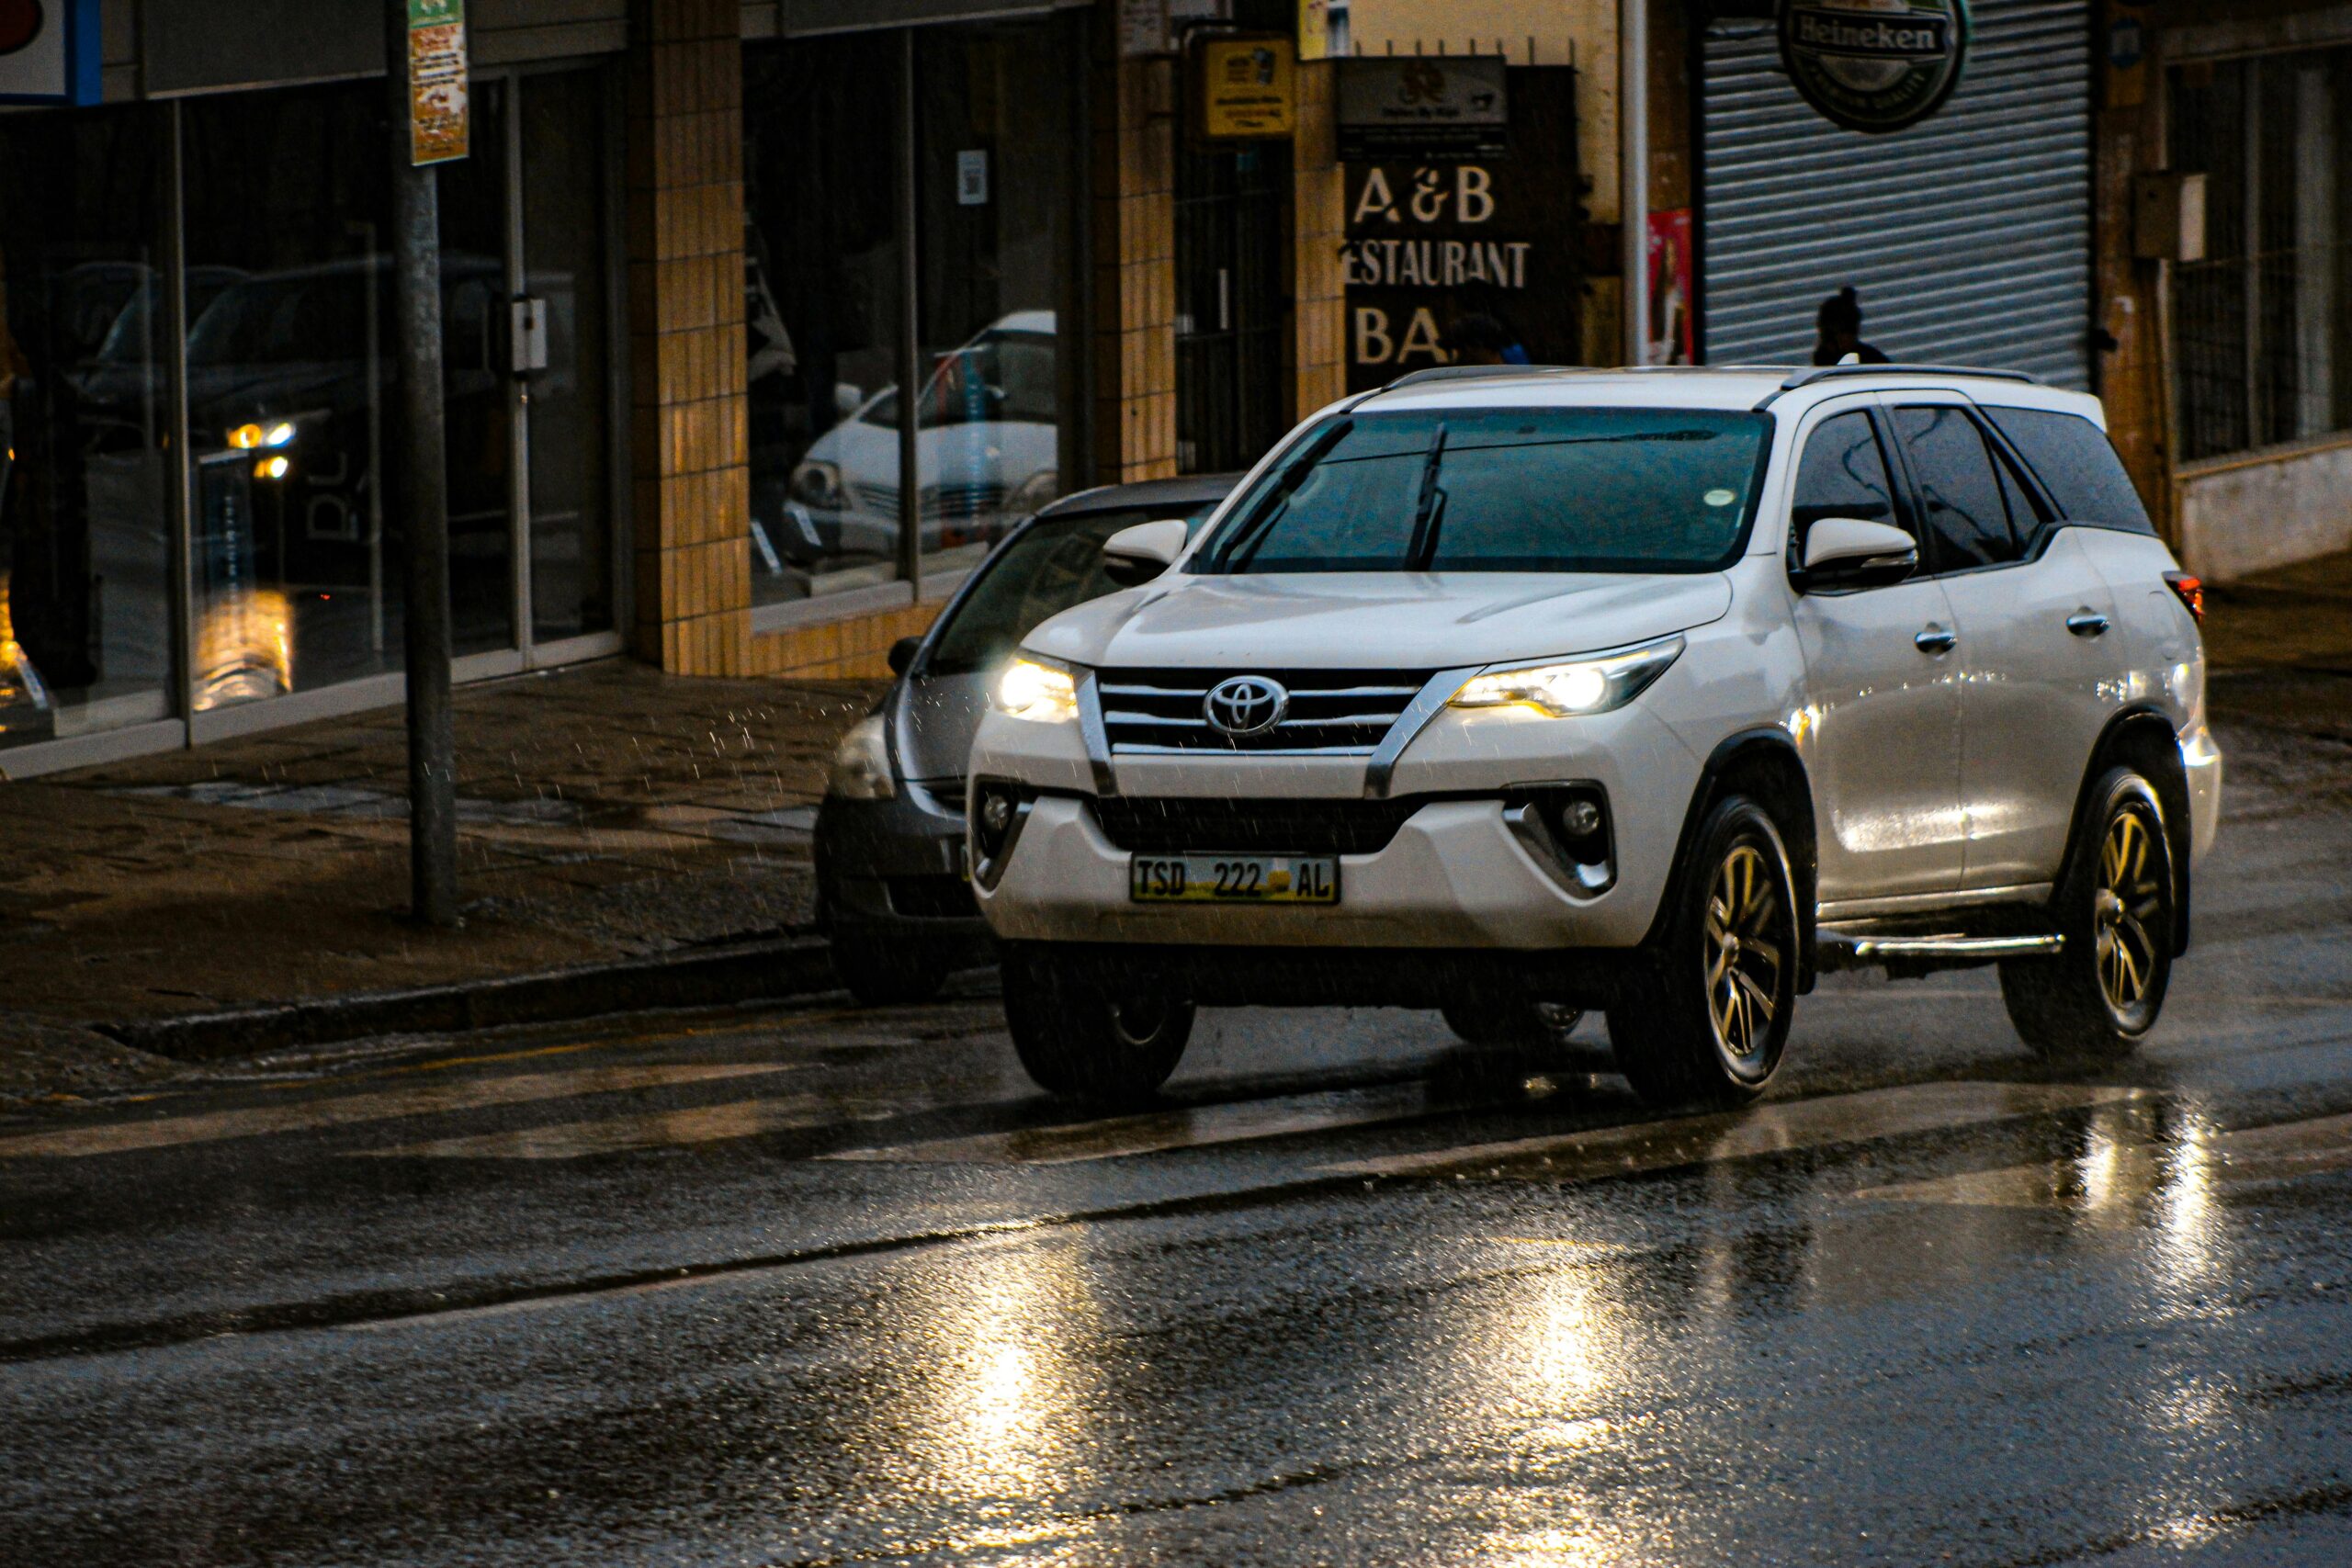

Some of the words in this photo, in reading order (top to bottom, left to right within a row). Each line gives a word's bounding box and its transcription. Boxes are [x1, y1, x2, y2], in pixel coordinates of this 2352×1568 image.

[1798, 14, 1937, 51] Heineken
[1456, 165, 1495, 223] B
[1354, 307, 1458, 365] BA
[1137, 860, 1186, 897] TSD
[1214, 862, 1262, 897] 222
[1296, 862, 1330, 897] AL
